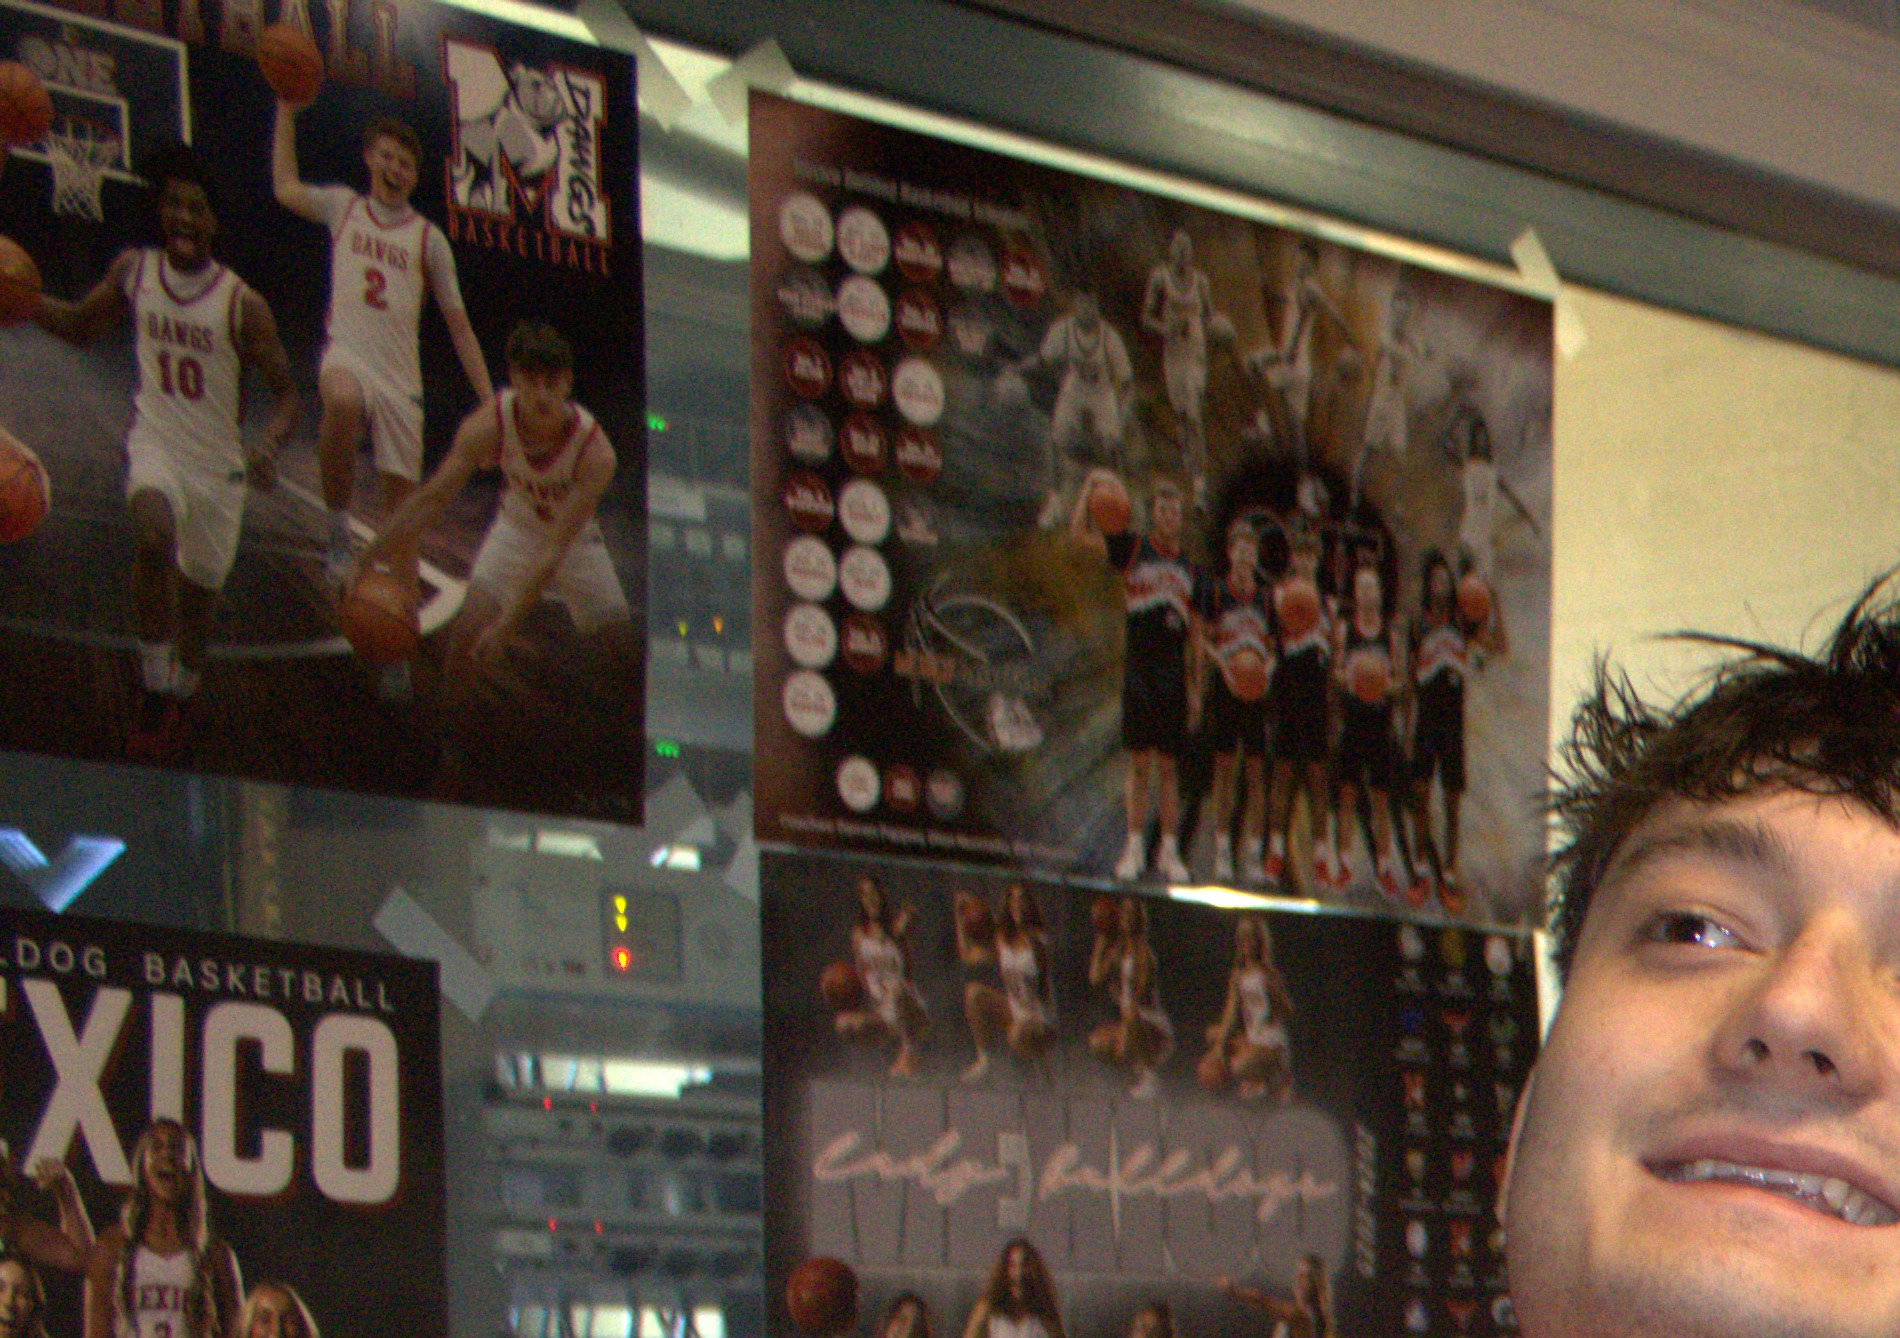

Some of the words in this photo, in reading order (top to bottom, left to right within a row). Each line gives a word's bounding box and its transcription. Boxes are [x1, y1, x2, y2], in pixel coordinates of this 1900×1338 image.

[364, 267, 390, 311] 2
[157, 350, 206, 403] 10
[144, 950, 396, 1014] BASKETBALL
[0, 976, 400, 1204] XICO
